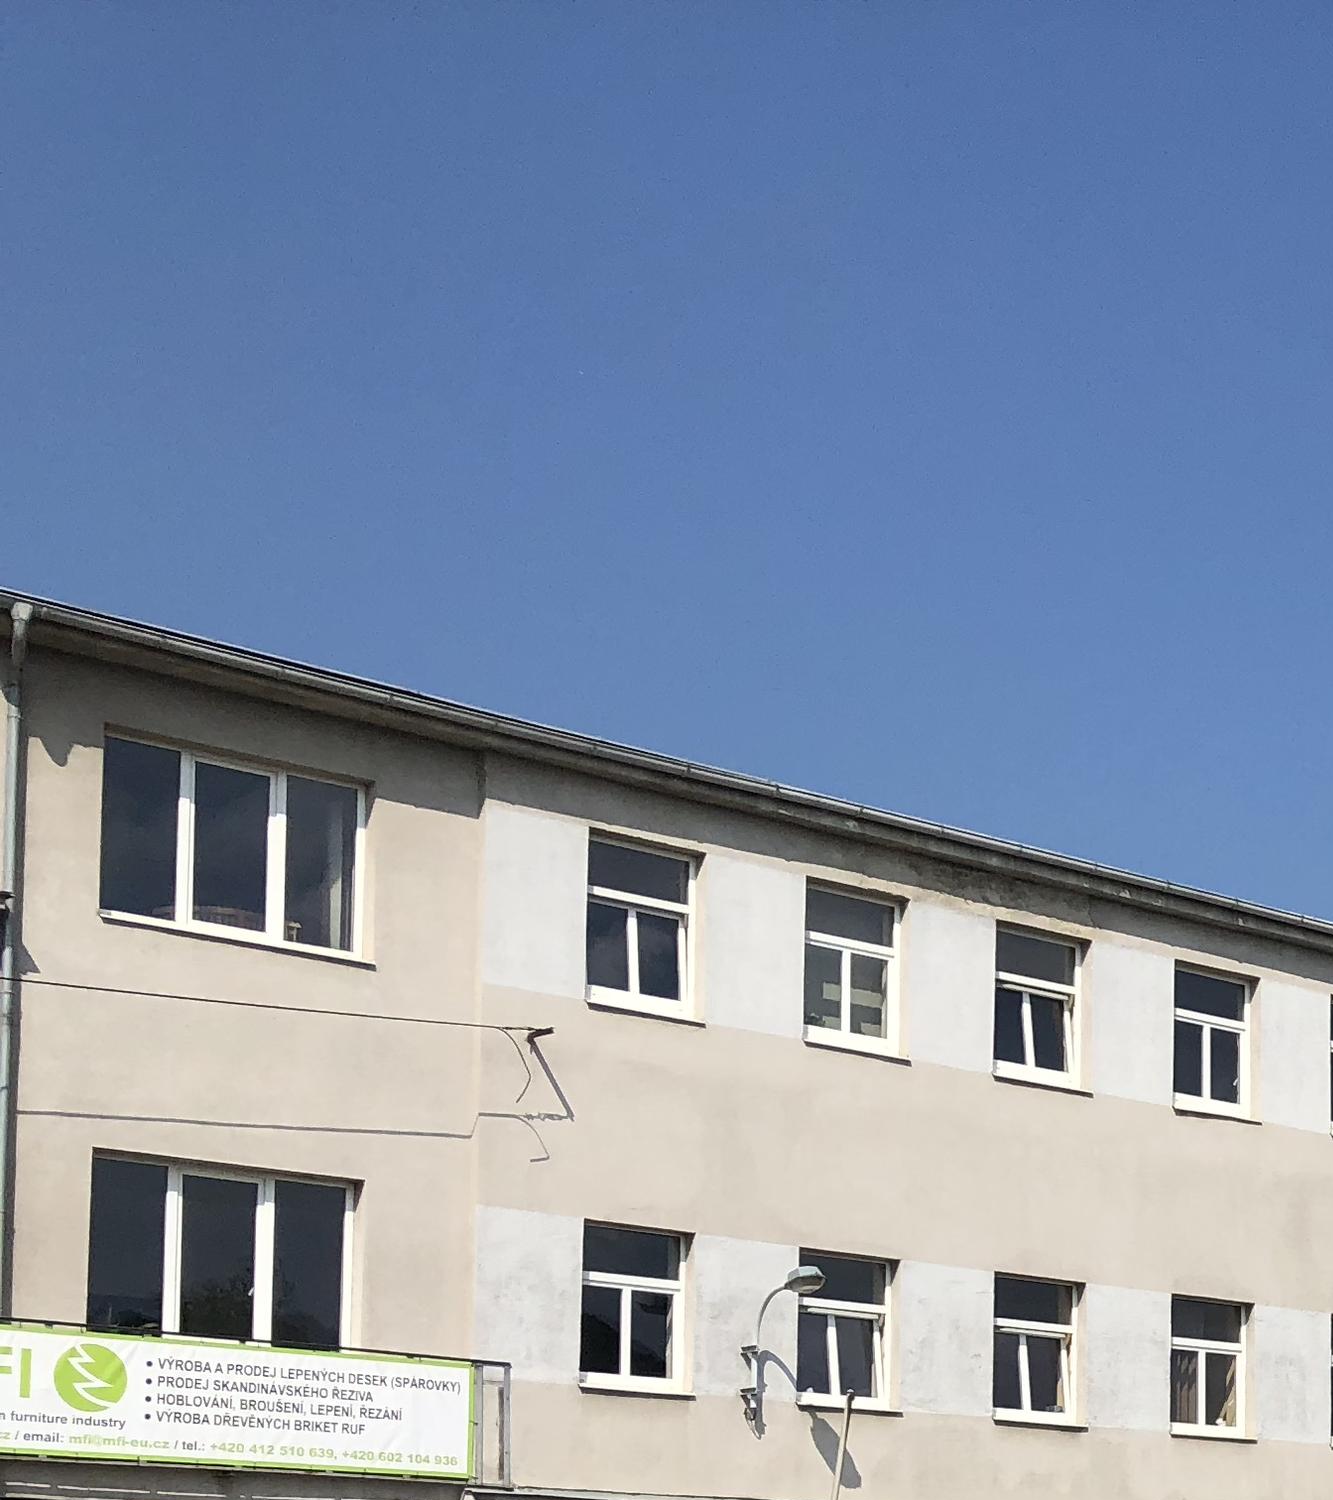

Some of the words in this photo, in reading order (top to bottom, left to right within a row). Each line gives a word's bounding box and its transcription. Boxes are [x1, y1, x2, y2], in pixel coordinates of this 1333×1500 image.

[158, 1356, 212, 1373] VÝROBA
[215, 1363, 224, 1374] A
[227, 1364, 277, 1378] PRODEJ
[281, 1367, 345, 1383] LEPENÝCH
[349, 1373, 388, 1387] DESEK
[391, 1375, 461, 1395] (SPÁROVKY)
[157, 1376, 209, 1390] PRODEJ
[213, 1380, 328, 1399] SKANDINÁVSKÉHO
[332, 1387, 373, 1402] ŘEZIVA
[157, 1393, 236, 1411] HOBLOVÁNÍ,
[240, 1398, 307, 1416] BROUŠENÍ,
[310, 1403, 356, 1419] LEPENÍ,
[359, 1405, 403, 1420] ŘEZÁNÍ
[10, 1411, 68, 1425] furniture
[72, 1415, 126, 1430] industry
[156, 1409, 210, 1425] VÝROBA
[213, 1412, 290, 1430] DŘEVĚNÝCH
[294, 1420, 338, 1433] BRIKET
[341, 1423, 365, 1435] RUF
[23, 1432, 65, 1443] email:
[210, 1442, 244, 1453] +420
[249, 1444, 274, 1455] 412
[280, 1445, 304, 1457] 510
[342, 1450, 375, 1461] +420
[378, 1452, 402, 1463] 602
[408, 1454, 430, 1464] 104
